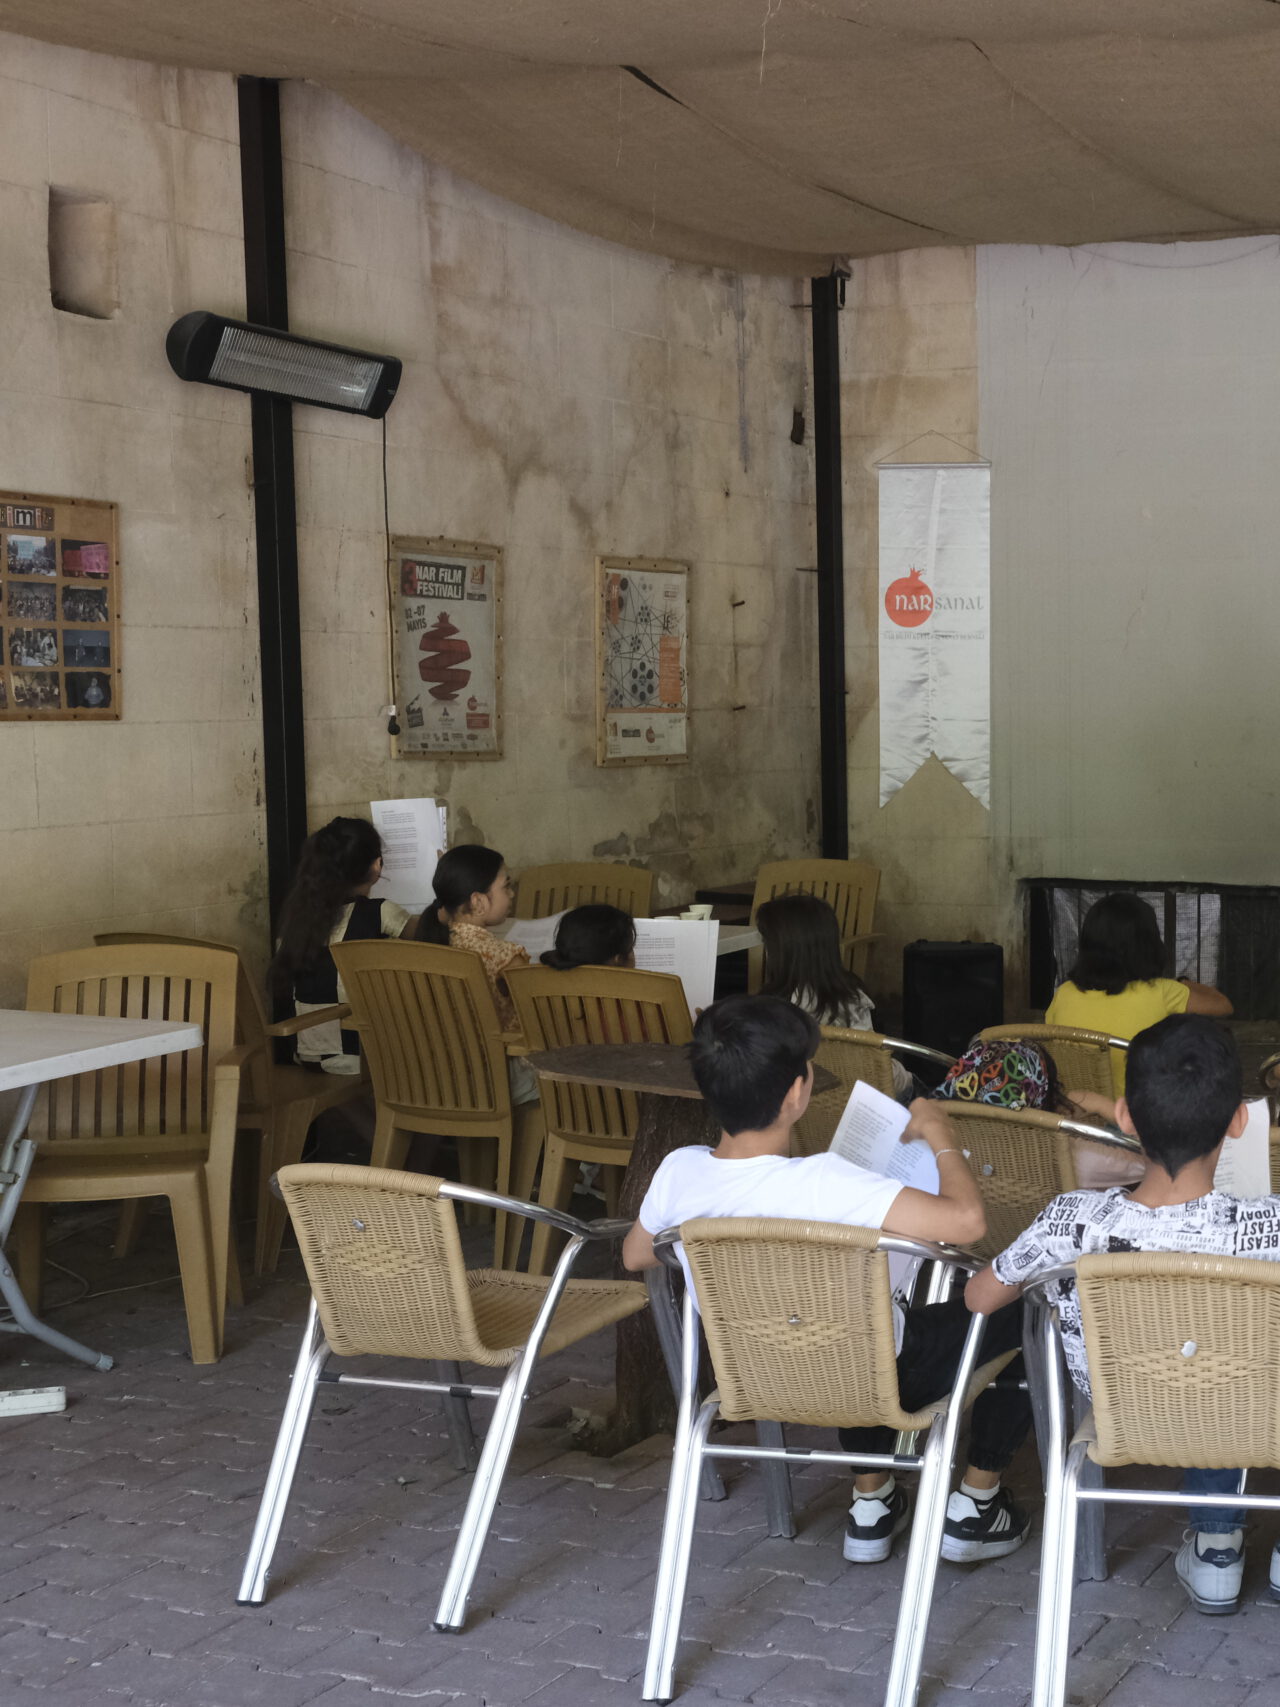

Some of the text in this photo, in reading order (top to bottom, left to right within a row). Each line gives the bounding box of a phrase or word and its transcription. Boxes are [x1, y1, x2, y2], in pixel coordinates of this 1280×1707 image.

[415, 565, 436, 582] NAR
[1239, 1206, 1277, 1222] TODAY
[1241, 1218, 1280, 1236] FEAST
[1239, 1234, 1279, 1252] BEAST
